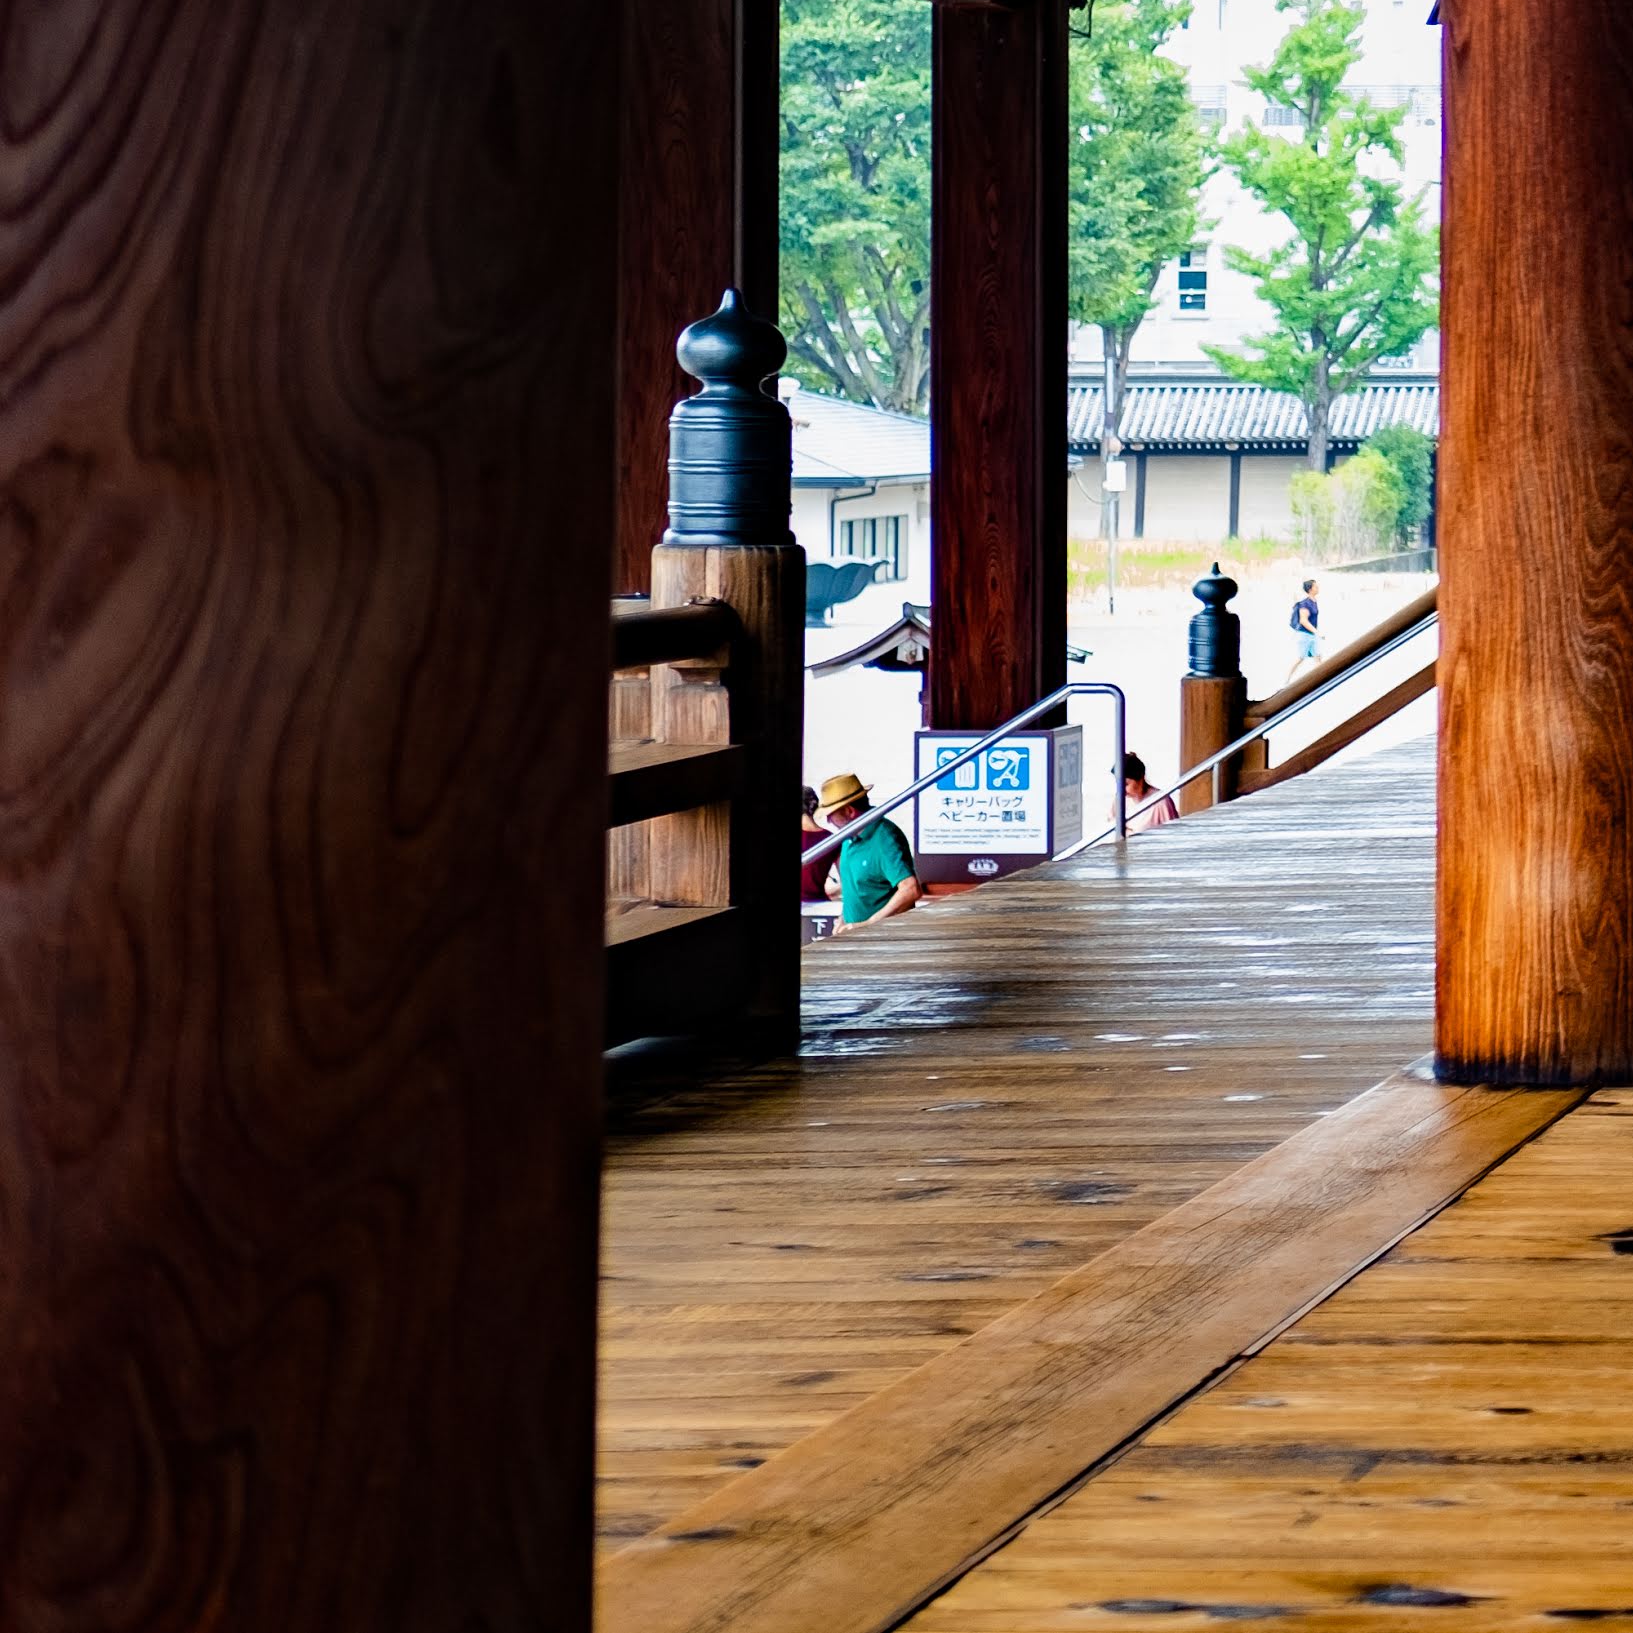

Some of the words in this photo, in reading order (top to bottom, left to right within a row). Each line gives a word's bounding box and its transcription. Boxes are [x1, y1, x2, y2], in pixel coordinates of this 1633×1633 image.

[941, 795, 1024, 809] キャリーバッグ
